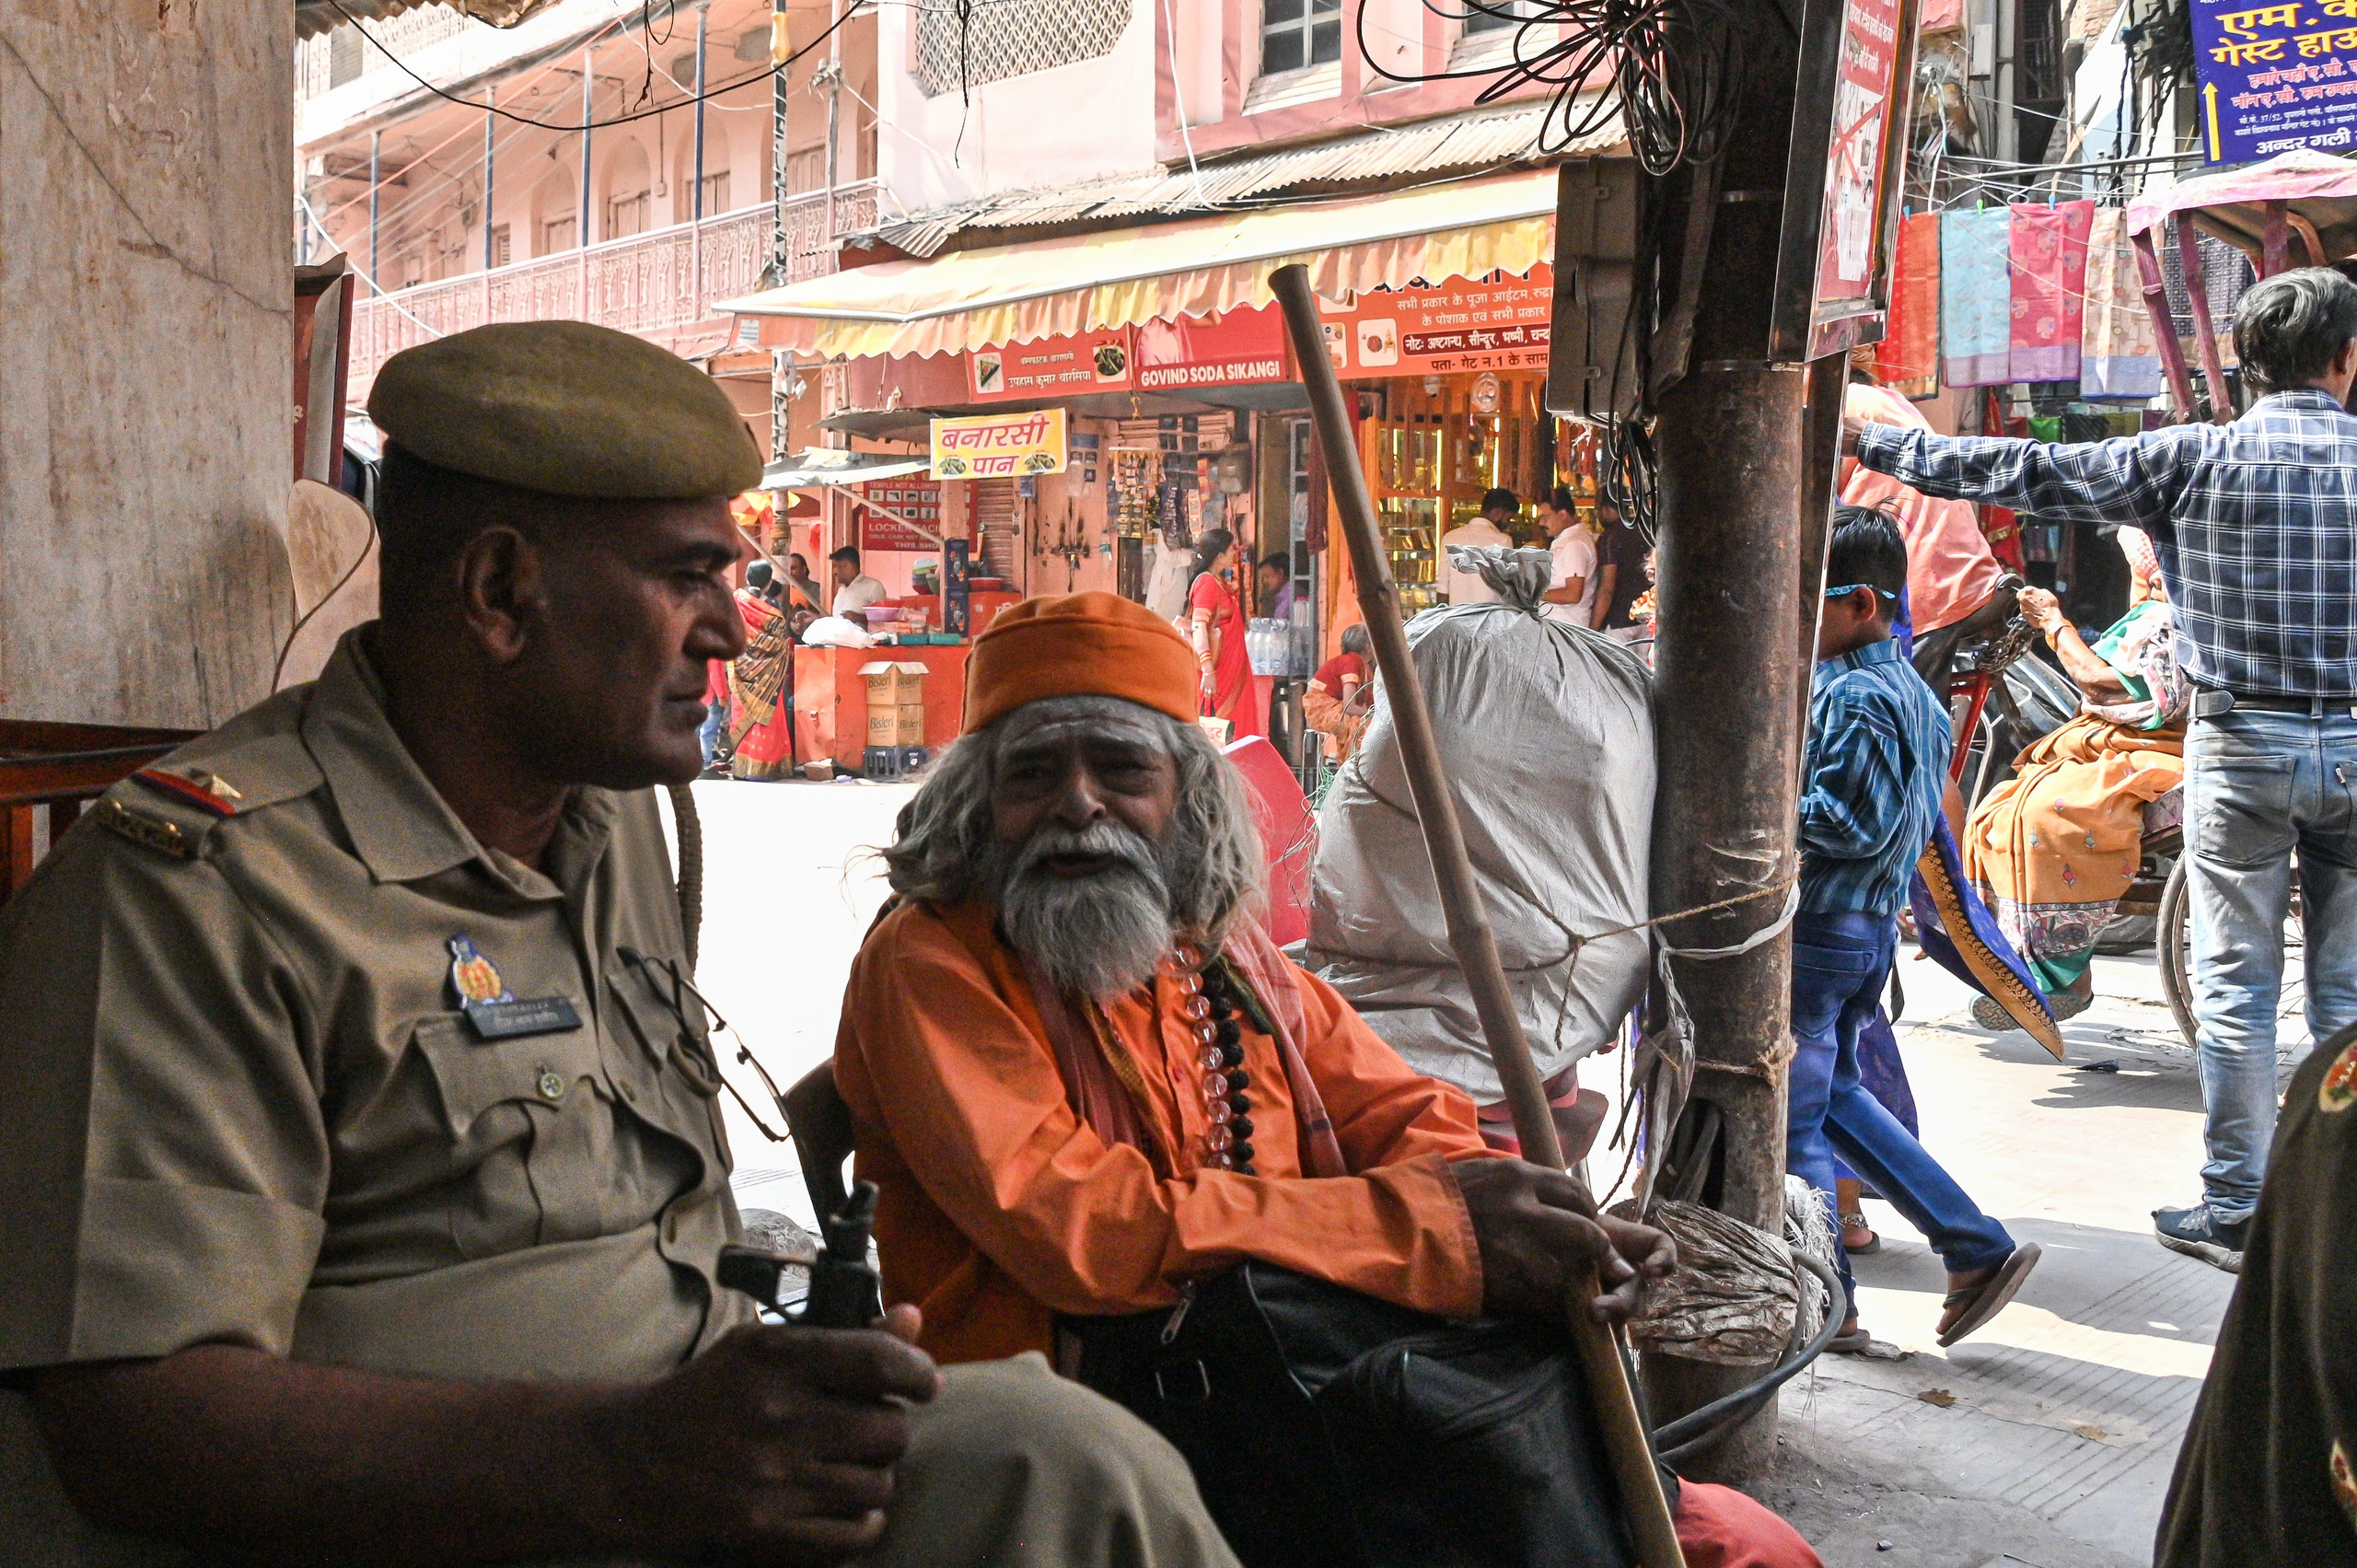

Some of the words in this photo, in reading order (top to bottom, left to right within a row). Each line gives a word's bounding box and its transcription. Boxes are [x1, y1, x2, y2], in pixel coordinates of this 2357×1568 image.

[2209, 38, 2288, 66] गेस्ट
[2256, 137, 2307, 155] अन्दर
[2309, 126, 2351, 146] गली
[1397, 296, 1417, 310] सभी
[1422, 296, 1447, 309] प्रकार
[1452, 292, 1463, 306] के
[1467, 293, 1488, 308] पूजा
[1422, 313, 1432, 326] के
[1436, 311, 1469, 325] पोशाक
[1473, 308, 1487, 322] एवं
[1491, 306, 1513, 321] सभी
[1517, 307, 1545, 319] प्रकार
[1461, 354, 1478, 368] गेट
[1508, 352, 1520, 366] के
[1141, 367, 1188, 387] GOVIND
[1190, 365, 1225, 383] SODA
[1226, 361, 1280, 380] SIKANGI
[941, 413, 1050, 449] बनारसी
[972, 456, 1019, 474] पान
[868, 673, 891, 688] Bisleri
[870, 715, 894, 729] Bisleri
